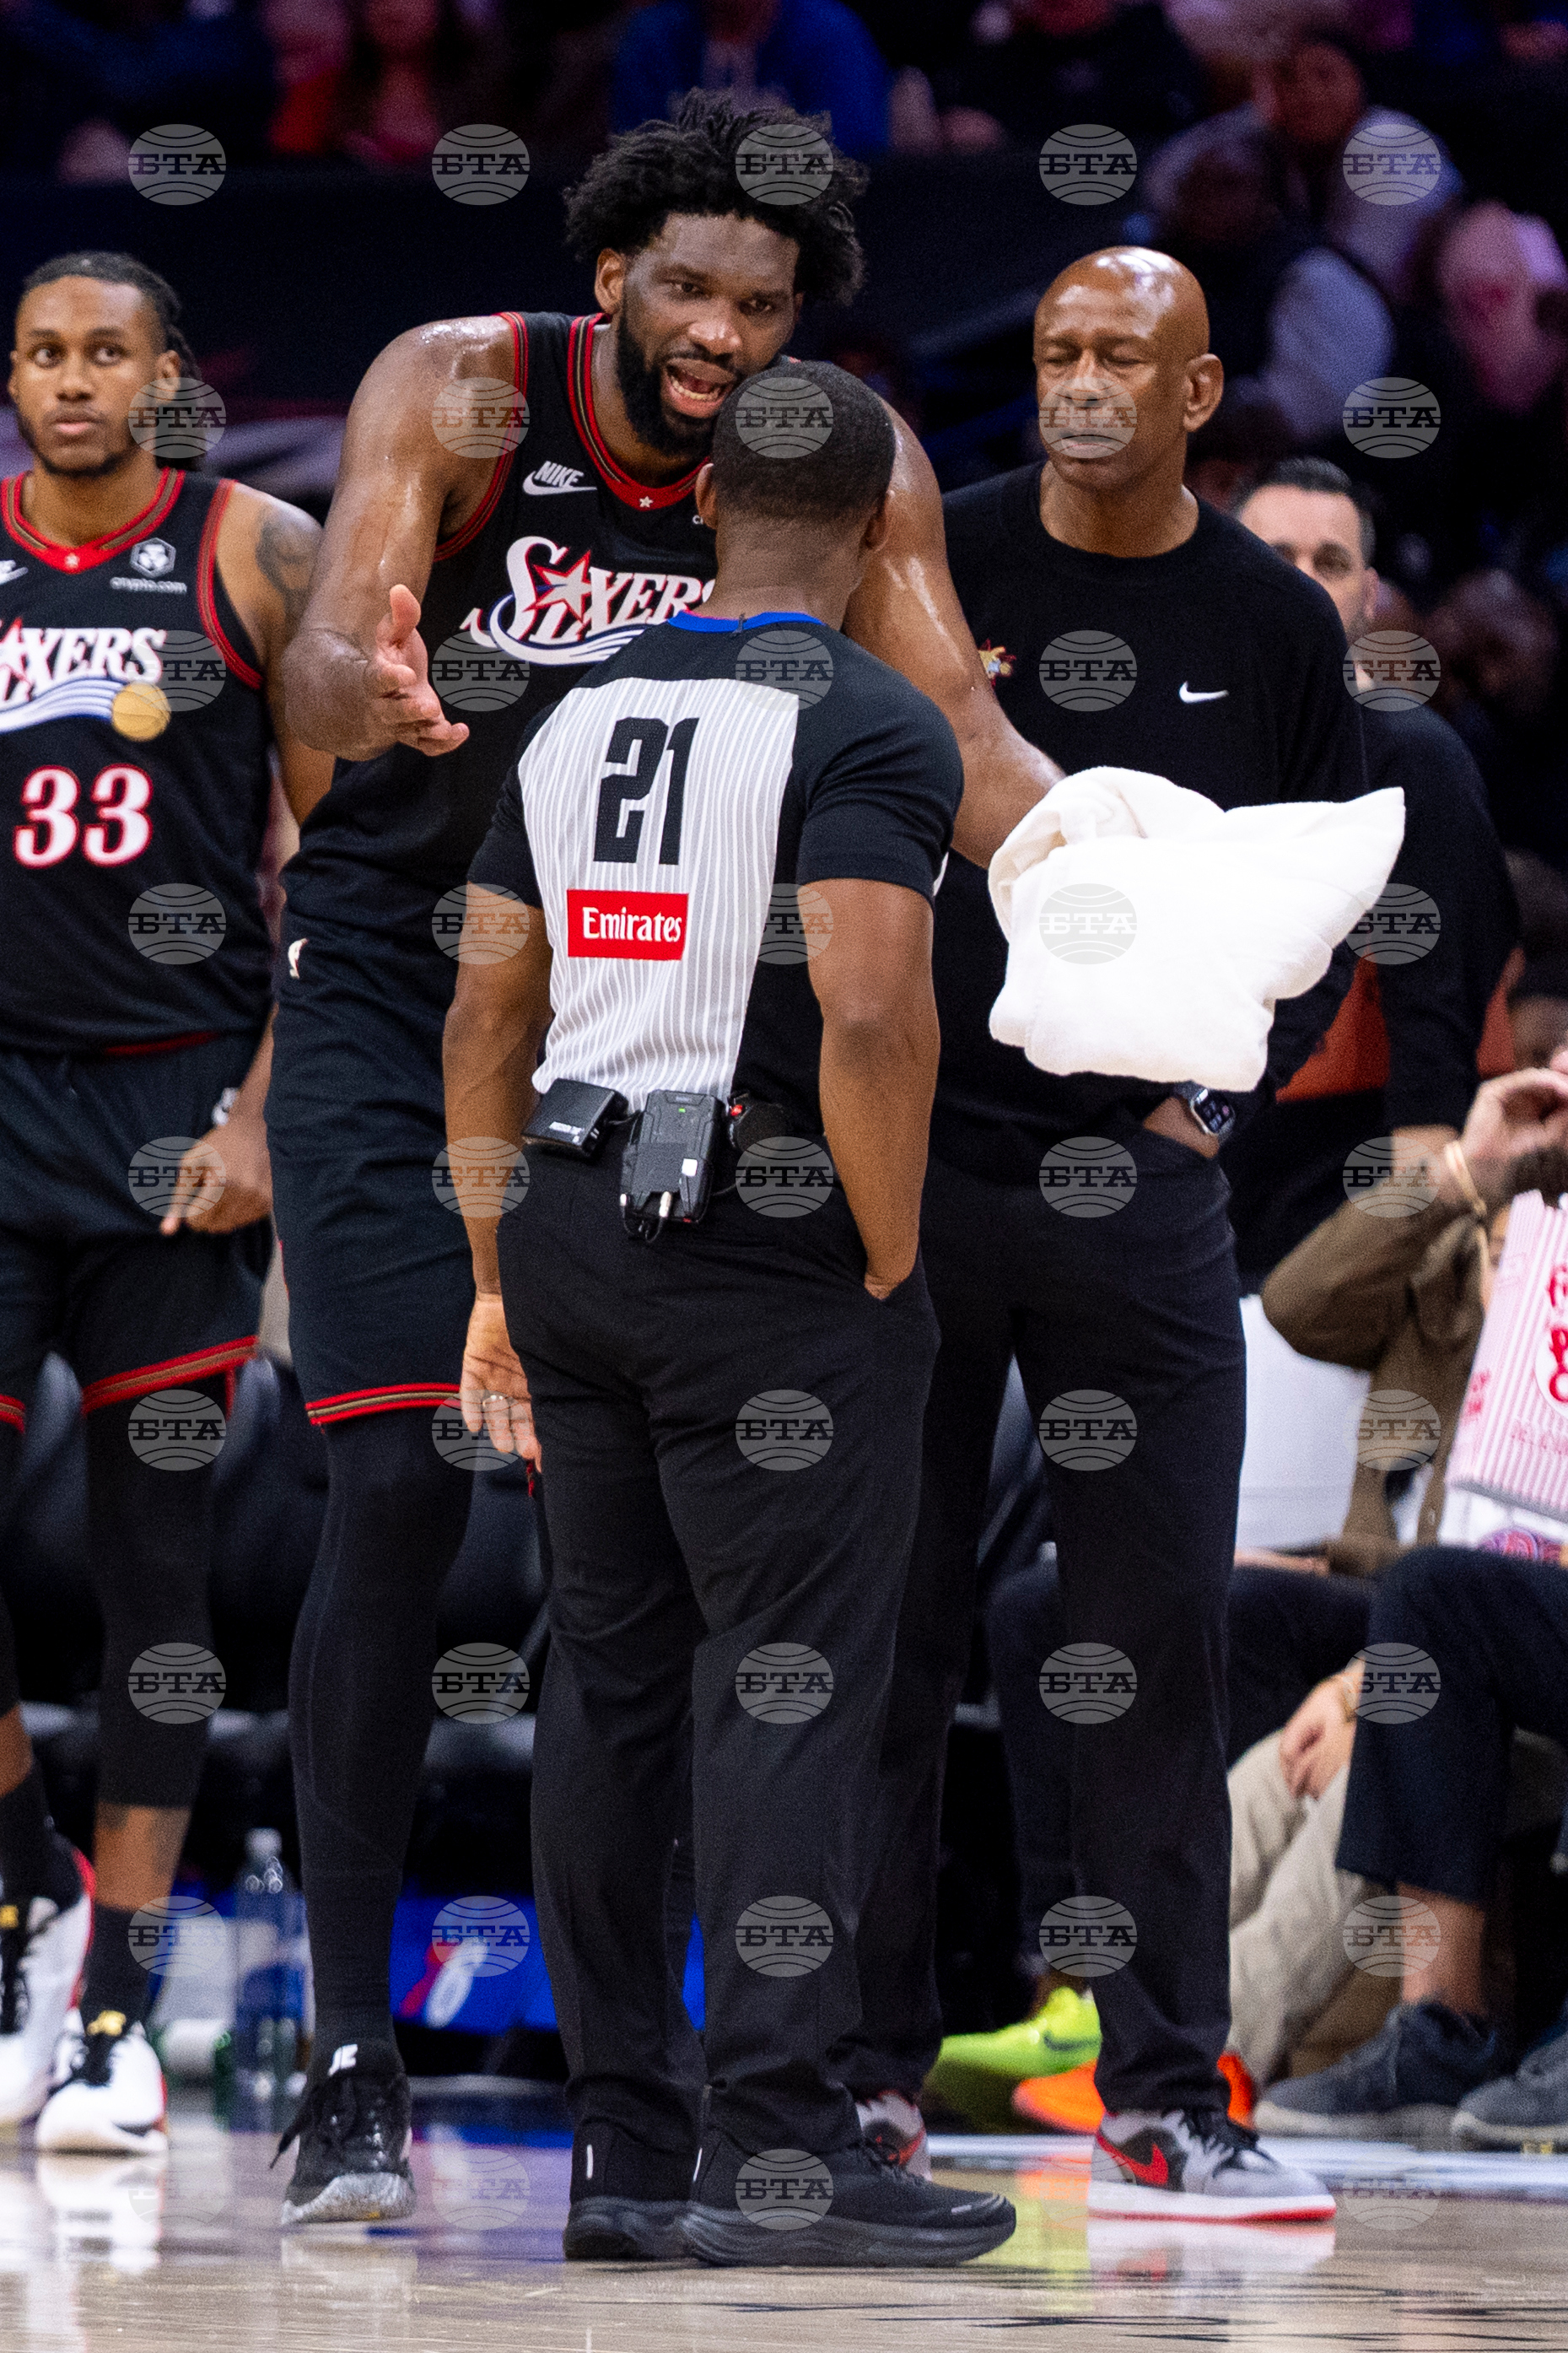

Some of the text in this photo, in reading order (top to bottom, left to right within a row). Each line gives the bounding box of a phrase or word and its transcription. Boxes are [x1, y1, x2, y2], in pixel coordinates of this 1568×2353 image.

[534, 460, 585, 488] NIKE
[460, 536, 716, 650] SIXER
[13, 764, 154, 870] 33
[593, 716, 700, 866] 21
[582, 906, 682, 942] Emirates
